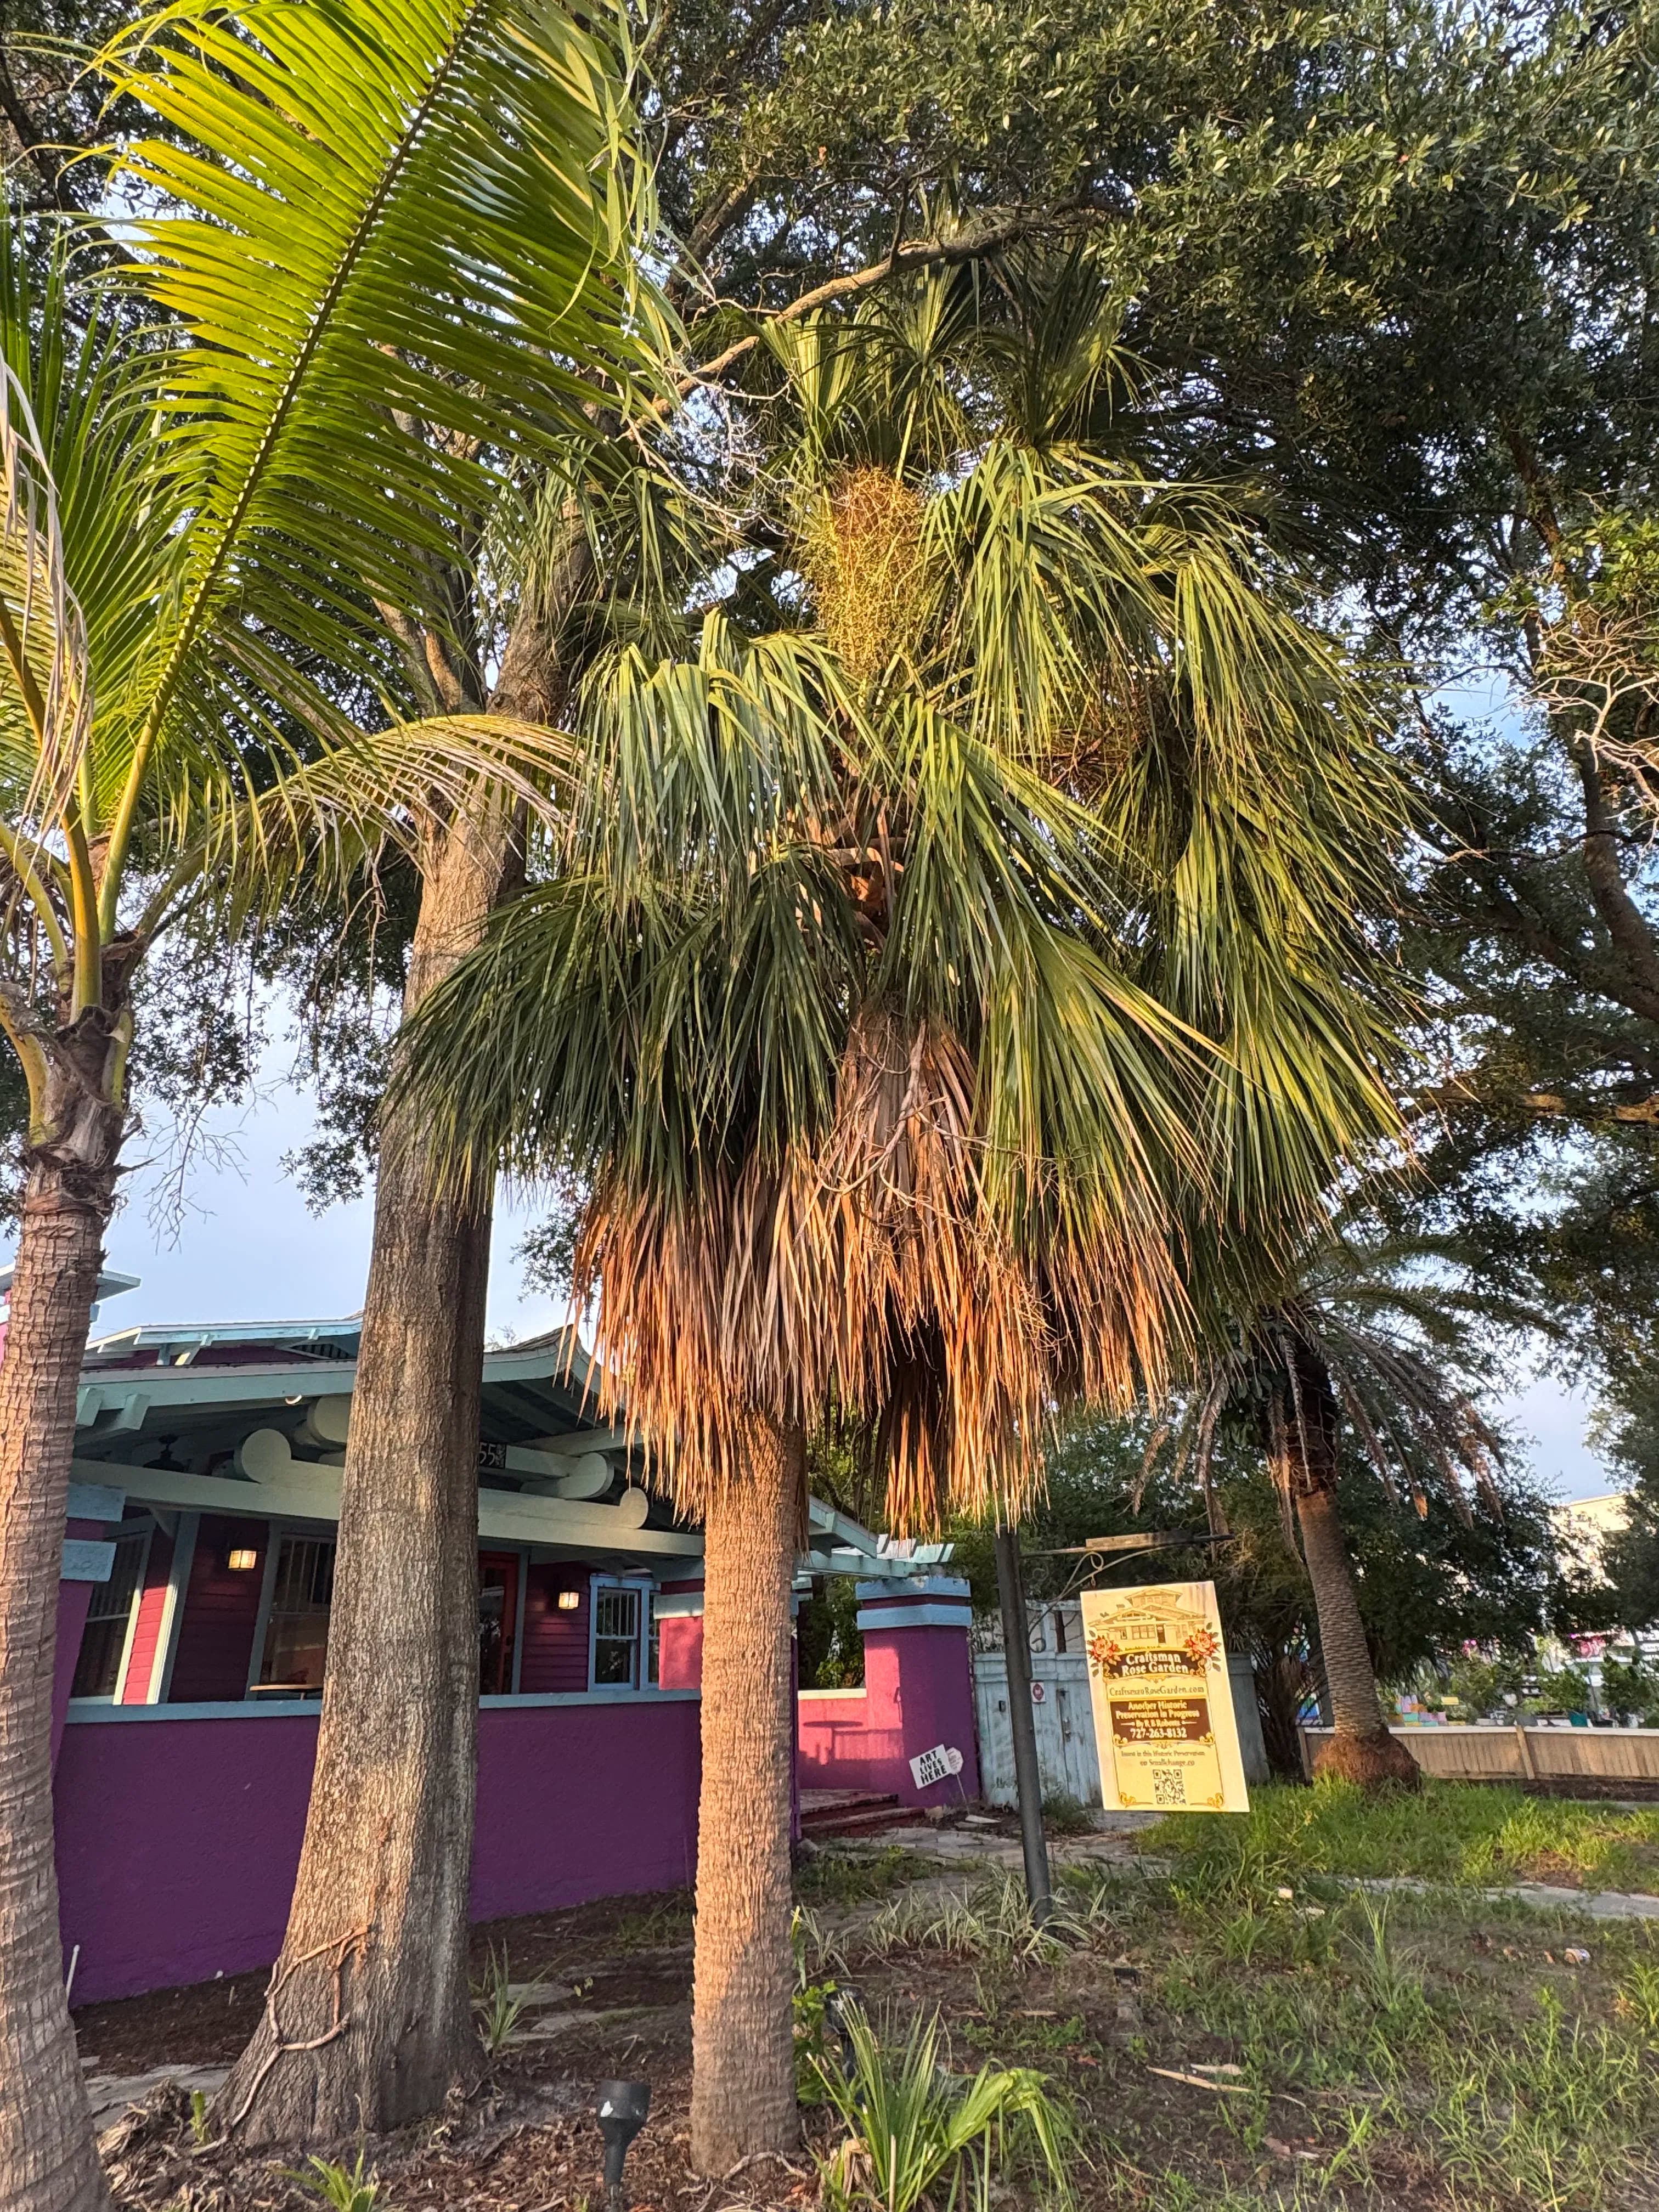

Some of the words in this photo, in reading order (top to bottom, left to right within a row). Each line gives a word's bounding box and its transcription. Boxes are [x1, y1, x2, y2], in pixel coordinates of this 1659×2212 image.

[1126, 1651, 1182, 1665] Craftsman
[1122, 1664, 1147, 1677] Rose
[1148, 1661, 1189, 1673] Garden
[1109, 1685, 1204, 1696] CraftsmanRoseGarden.com
[1128, 1701, 1156, 1710] Another
[1158, 1700, 1187, 1709] Historic
[1116, 1710, 1159, 1719] Preservation
[1169, 1709, 1200, 1719] Progress
[1136, 1720, 1143, 1728] By
[1130, 1727, 1187, 1739] 727-263-8132
[919, 1750, 938, 1765] ART
[920, 1758, 942, 1774] LIVES
[921, 1765, 947, 1785] HERE
